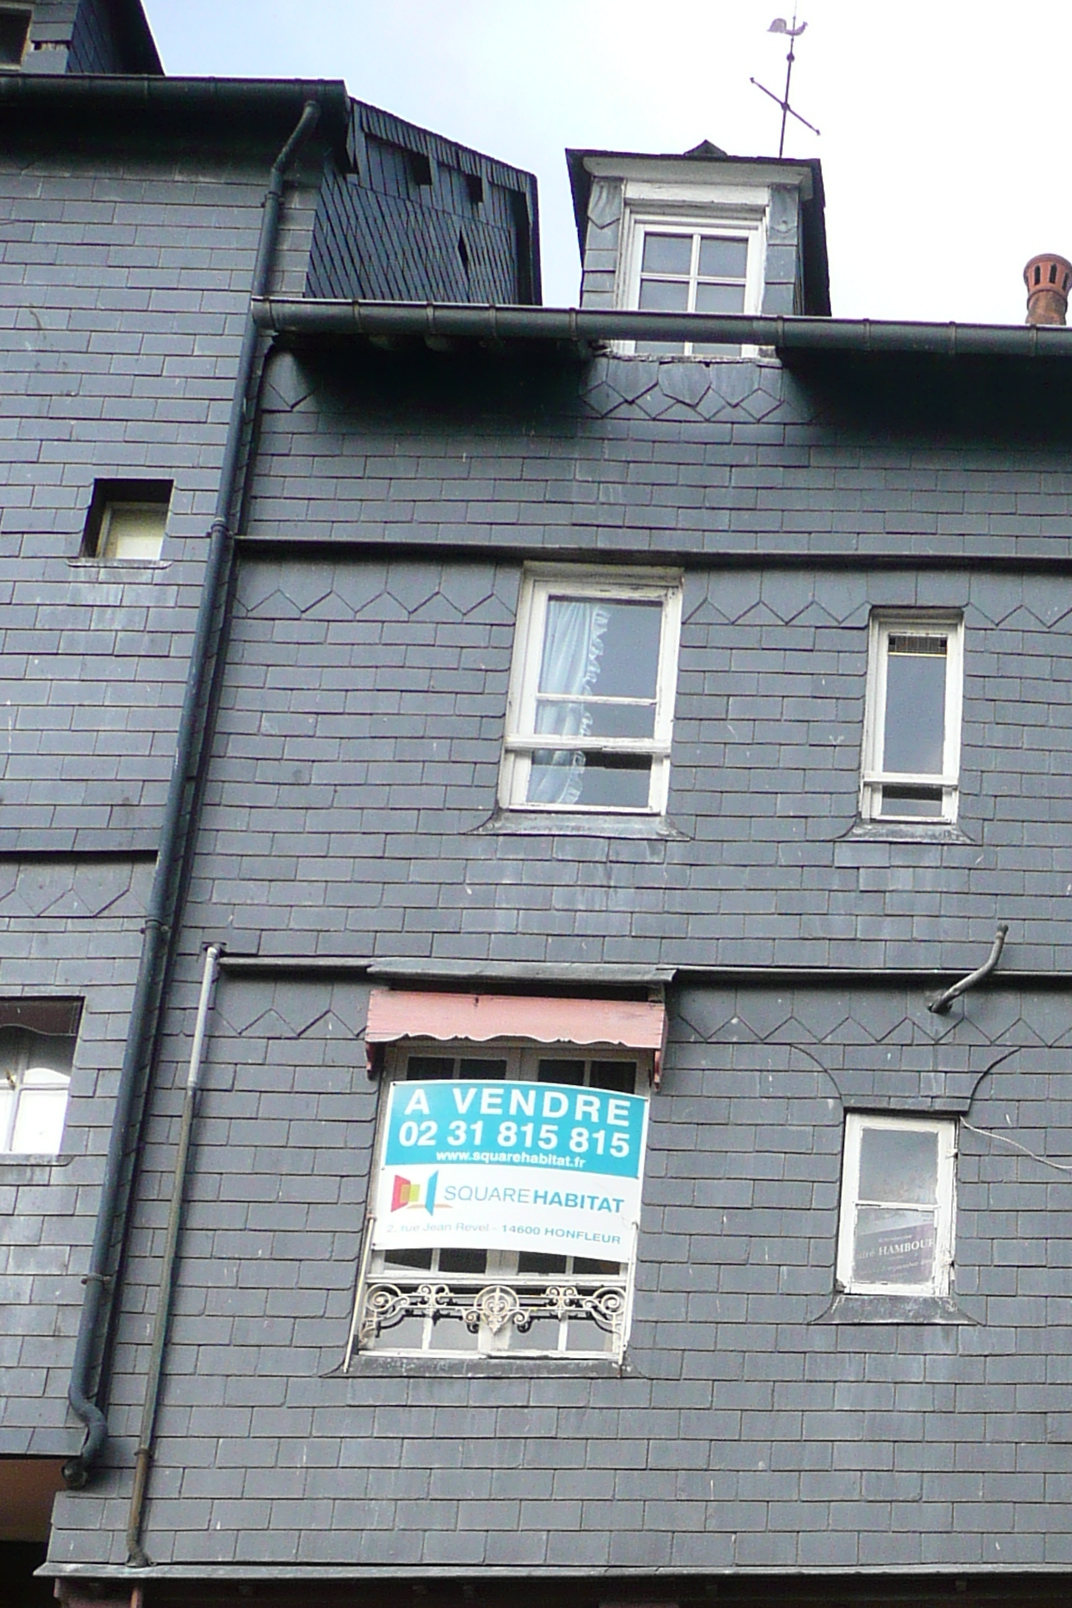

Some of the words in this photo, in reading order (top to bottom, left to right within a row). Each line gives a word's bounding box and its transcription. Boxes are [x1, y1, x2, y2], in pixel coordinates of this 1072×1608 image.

[404, 1088, 431, 1115] A
[452, 1088, 631, 1127] VENDRE
[399, 1121, 438, 1147] 02
[447, 1120, 483, 1146] 31
[497, 1122, 559, 1150] 815
[569, 1127, 630, 1158] 815
[436, 1151, 586, 1168] www.squarehabitat.fr
[401, 1224, 420, 1233] rue
[423, 1222, 452, 1233] Jean
[455, 1222, 489, 1233] Revel
[501, 1224, 540, 1236] 14600
[544, 1227, 621, 1245] HONFLEUR
